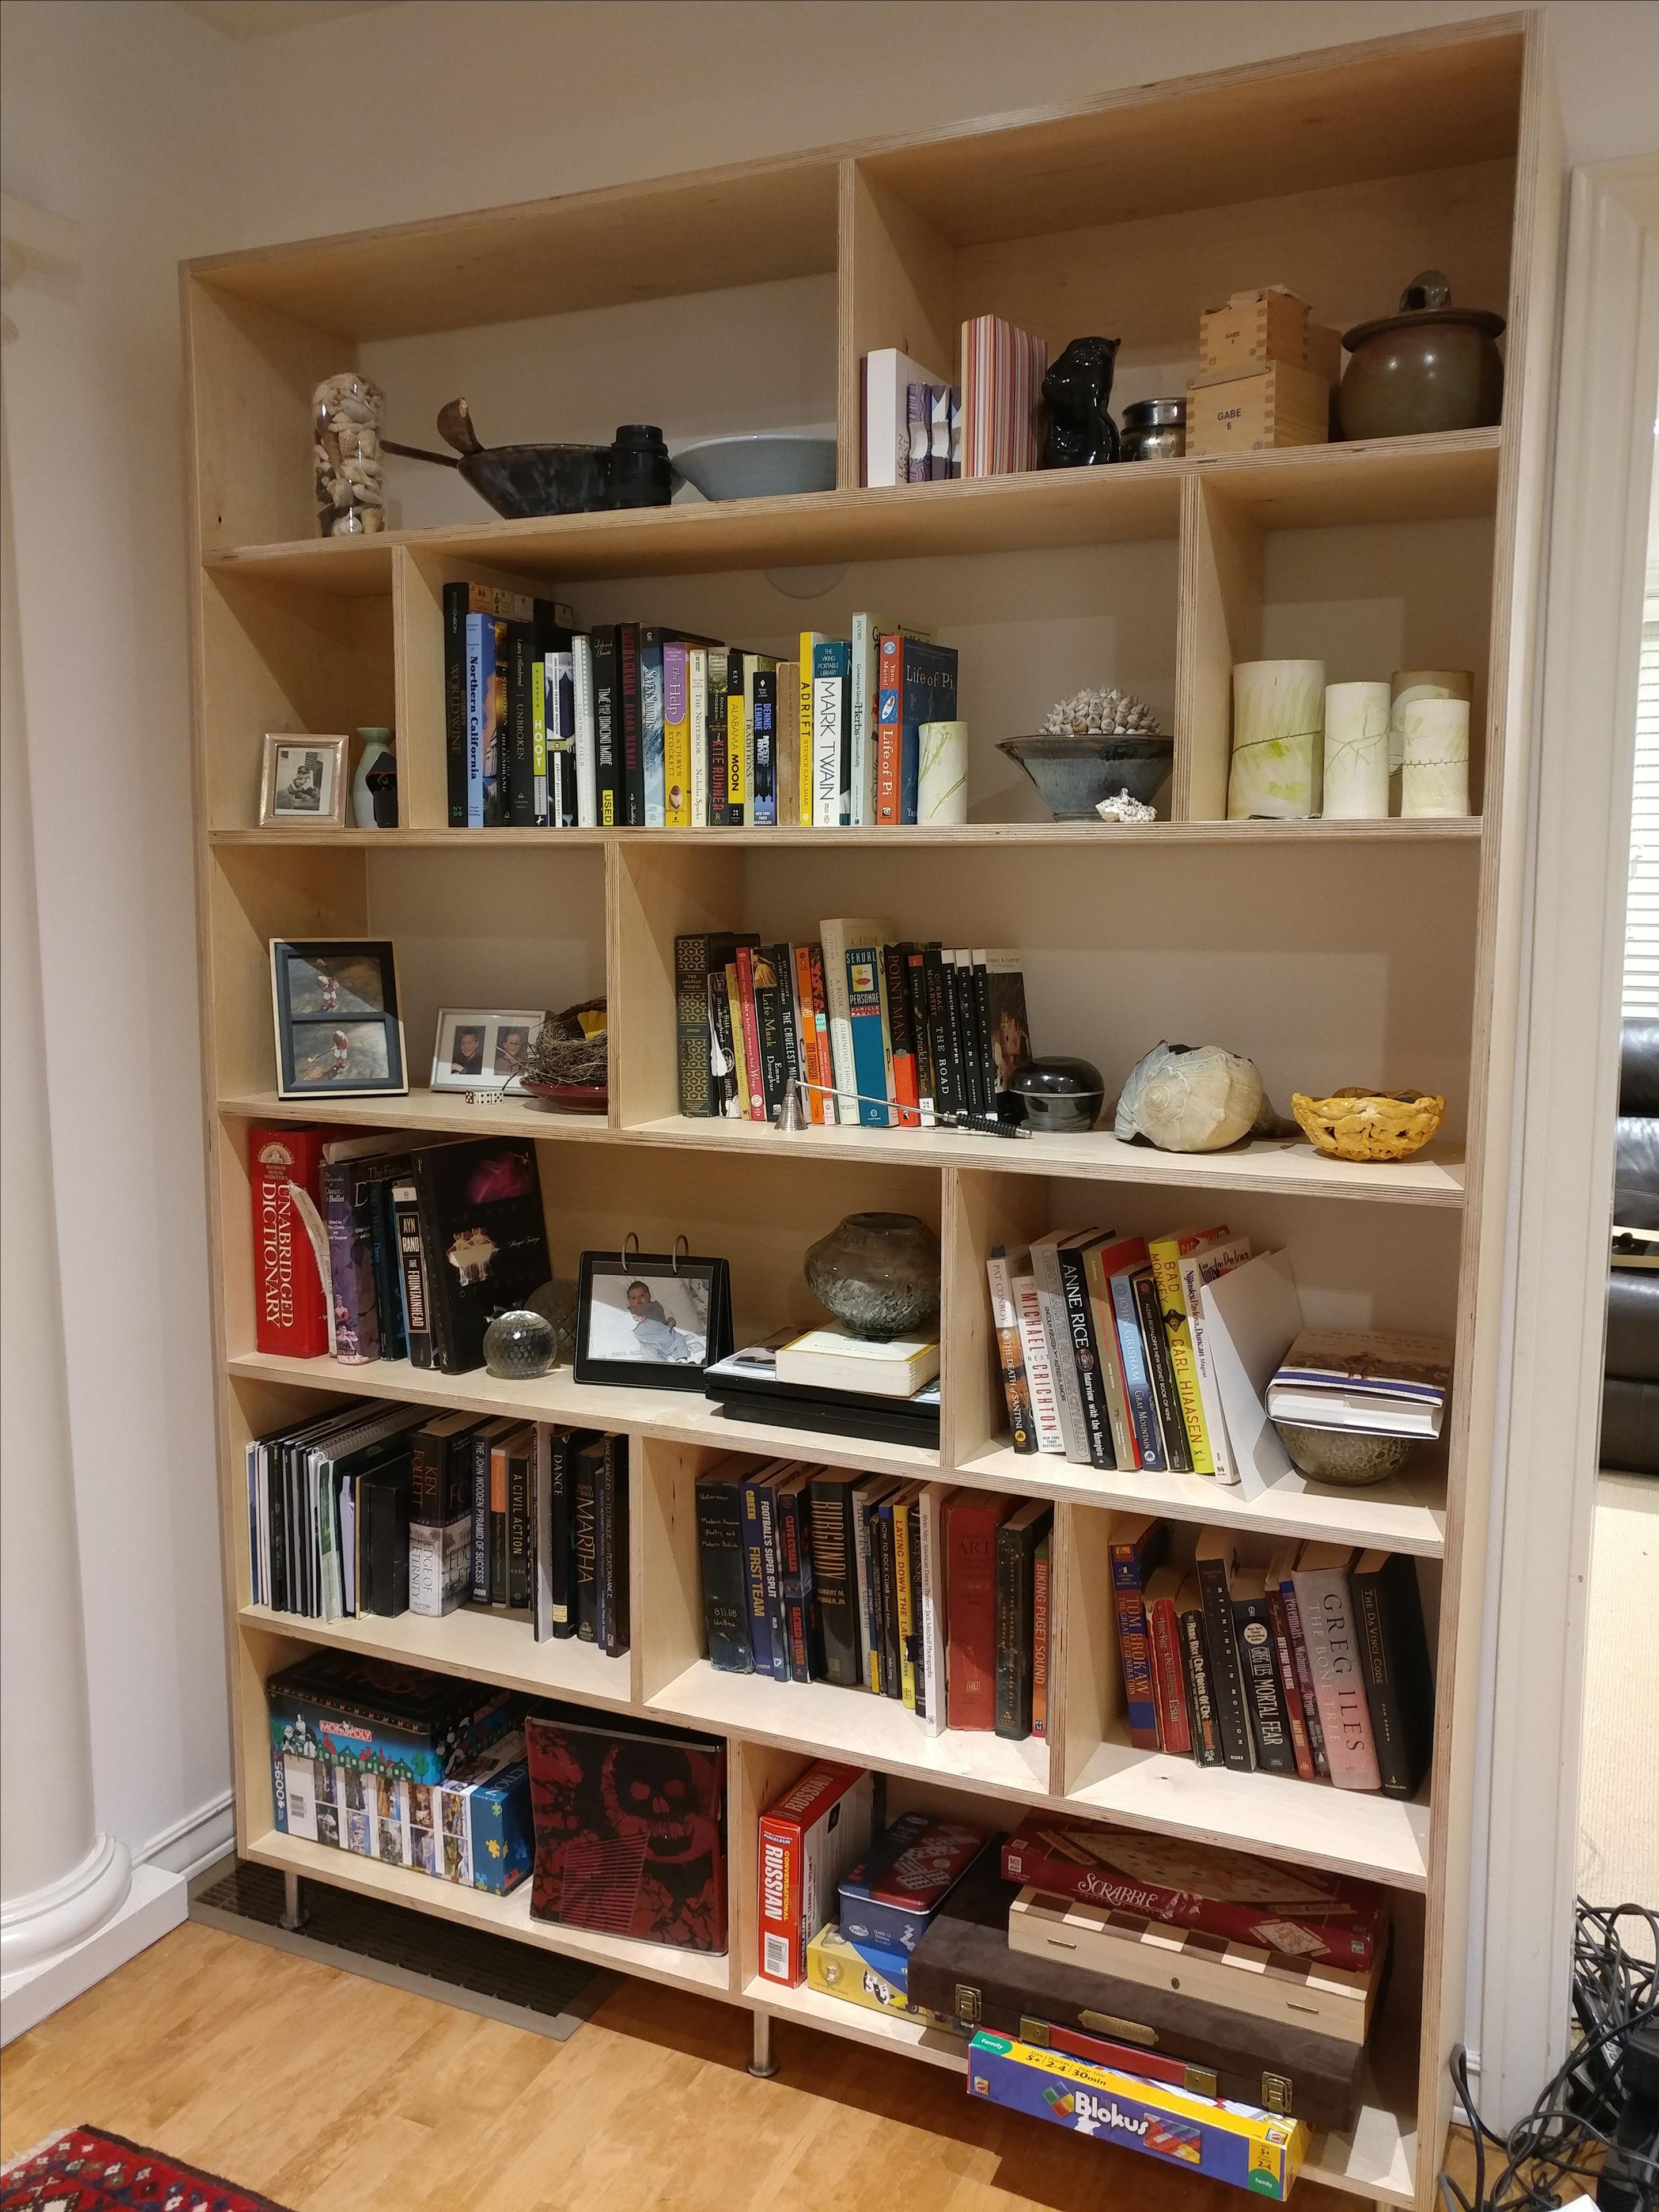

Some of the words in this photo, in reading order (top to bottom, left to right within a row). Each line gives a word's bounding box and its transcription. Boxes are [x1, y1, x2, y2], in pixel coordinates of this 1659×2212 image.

[1217, 408, 1242, 421] GABE
[1227, 422, 1232, 430] 6
[470, 656, 479, 713] Northern
[906, 664, 926, 684] Life
[927, 672, 940, 687] of
[941, 673, 954, 690] Pi
[666, 683, 681, 715] Help
[755, 703, 763, 731] LEHANE
[763, 703, 771, 730] DENNIS
[801, 682, 810, 737] ADRIFT
[820, 681, 836, 737] MARK
[516, 703, 525, 760] UNBROKEN
[534, 719, 544, 768] HOOT
[731, 703, 739, 751] ALABAMA
[882, 729, 893, 759] Life
[470, 716, 479, 780] California
[712, 740, 724, 764] KITE
[732, 753, 740, 791] MOON
[819, 741, 835, 800] TWAIN
[882, 761, 892, 777] of
[712, 766, 725, 810] RUNNER
[882, 781, 893, 796] Pi
[604, 794, 612, 823] USED
[846, 951, 876, 964] SEXUAL
[888, 955, 903, 1002] POINT
[934, 974, 944, 1011] CORMAC
[762, 992, 774, 1016] Life
[839, 1010, 845, 1021] OF
[849, 992, 880, 1005] PERSONAE
[948, 988, 956, 1028] ORCHARD
[764, 1017, 777, 1048] Mask
[840, 1023, 849, 1063] LUMINOUS
[892, 1008, 906, 1042] MAN
[935, 1026, 945, 1052] THE
[982, 1020, 987, 1035] OF
[767, 1055, 776, 1092] Donoghue
[938, 1058, 949, 1094] ROAD
[403, 1217, 416, 1233] AYN
[262, 1181, 281, 1328] DICTIONARY
[278, 1183, 294, 1327] UNABRIDGED
[402, 1237, 419, 1253] RAND
[993, 1264, 1003, 1280] PAT
[1063, 1264, 1084, 1309] ANNE
[1150, 1253, 1169, 1304] MONKEY
[1164, 1261, 1180, 1293] BAD
[995, 1283, 1009, 1322] CONROY
[1020, 1292, 1046, 1352] MICHAEL
[1070, 1313, 1089, 1349] RICE
[1171, 1338, 1190, 1376] CARL
[1032, 1363, 1058, 1431] CRICHTON
[1134, 1389, 1145, 1410] GRAY
[1179, 1380, 1203, 1444] HIAASEN
[1138, 1410, 1151, 1449] MOUNTAIN
[425, 1467, 437, 1495] KEN
[553, 1454, 564, 1497] DANCE
[513, 1486, 522, 1513] CIVIL
[513, 1517, 522, 1555] ACTION
[577, 1498, 596, 1584] MARTHA
[810, 1499, 848, 1582] BURGUNDY
[881, 1522, 889, 1540] HOW
[882, 1541, 889, 1552] TO
[411, 1545, 423, 1600] ETERNITY
[748, 1546, 763, 1581] FIRST
[751, 1583, 766, 1618] TEAM
[1036, 1563, 1047, 1603] BIKING
[1035, 1605, 1047, 1643] PUGET
[1126, 1596, 1142, 1628] TOM
[1035, 1646, 1046, 1685] SOUND
[1129, 1632, 1150, 1695] BROKAW
[1308, 1601, 1324, 1637] THE
[1316, 1645, 1332, 1695] BONE
[1325, 1700, 1341, 1743] TREE
[1323, 1593, 1353, 1675] GREG
[1338, 1690, 1365, 1751] ILES
[1253, 1678, 1279, 1718] MORTAL
[320, 1722, 371, 1741] MONOPOLY
[1260, 1720, 1283, 1746] FEAR
[784, 1774, 835, 1813] RUSSIAN
[764, 1843, 785, 1922] RUSSIAN
[1078, 1873, 1158, 1910] SCRABBLE
[981, 2037, 1004, 2050] Family
[1025, 2054, 1041, 2063] 5+
[1045, 2061, 1066, 2072] 2-4
[1071, 2069, 1107, 2086] 30min
[1073, 2089, 1150, 2136] Blokus
[1255, 2177, 1273, 2188] Family
[1257, 2160, 1272, 2171] 2-4
